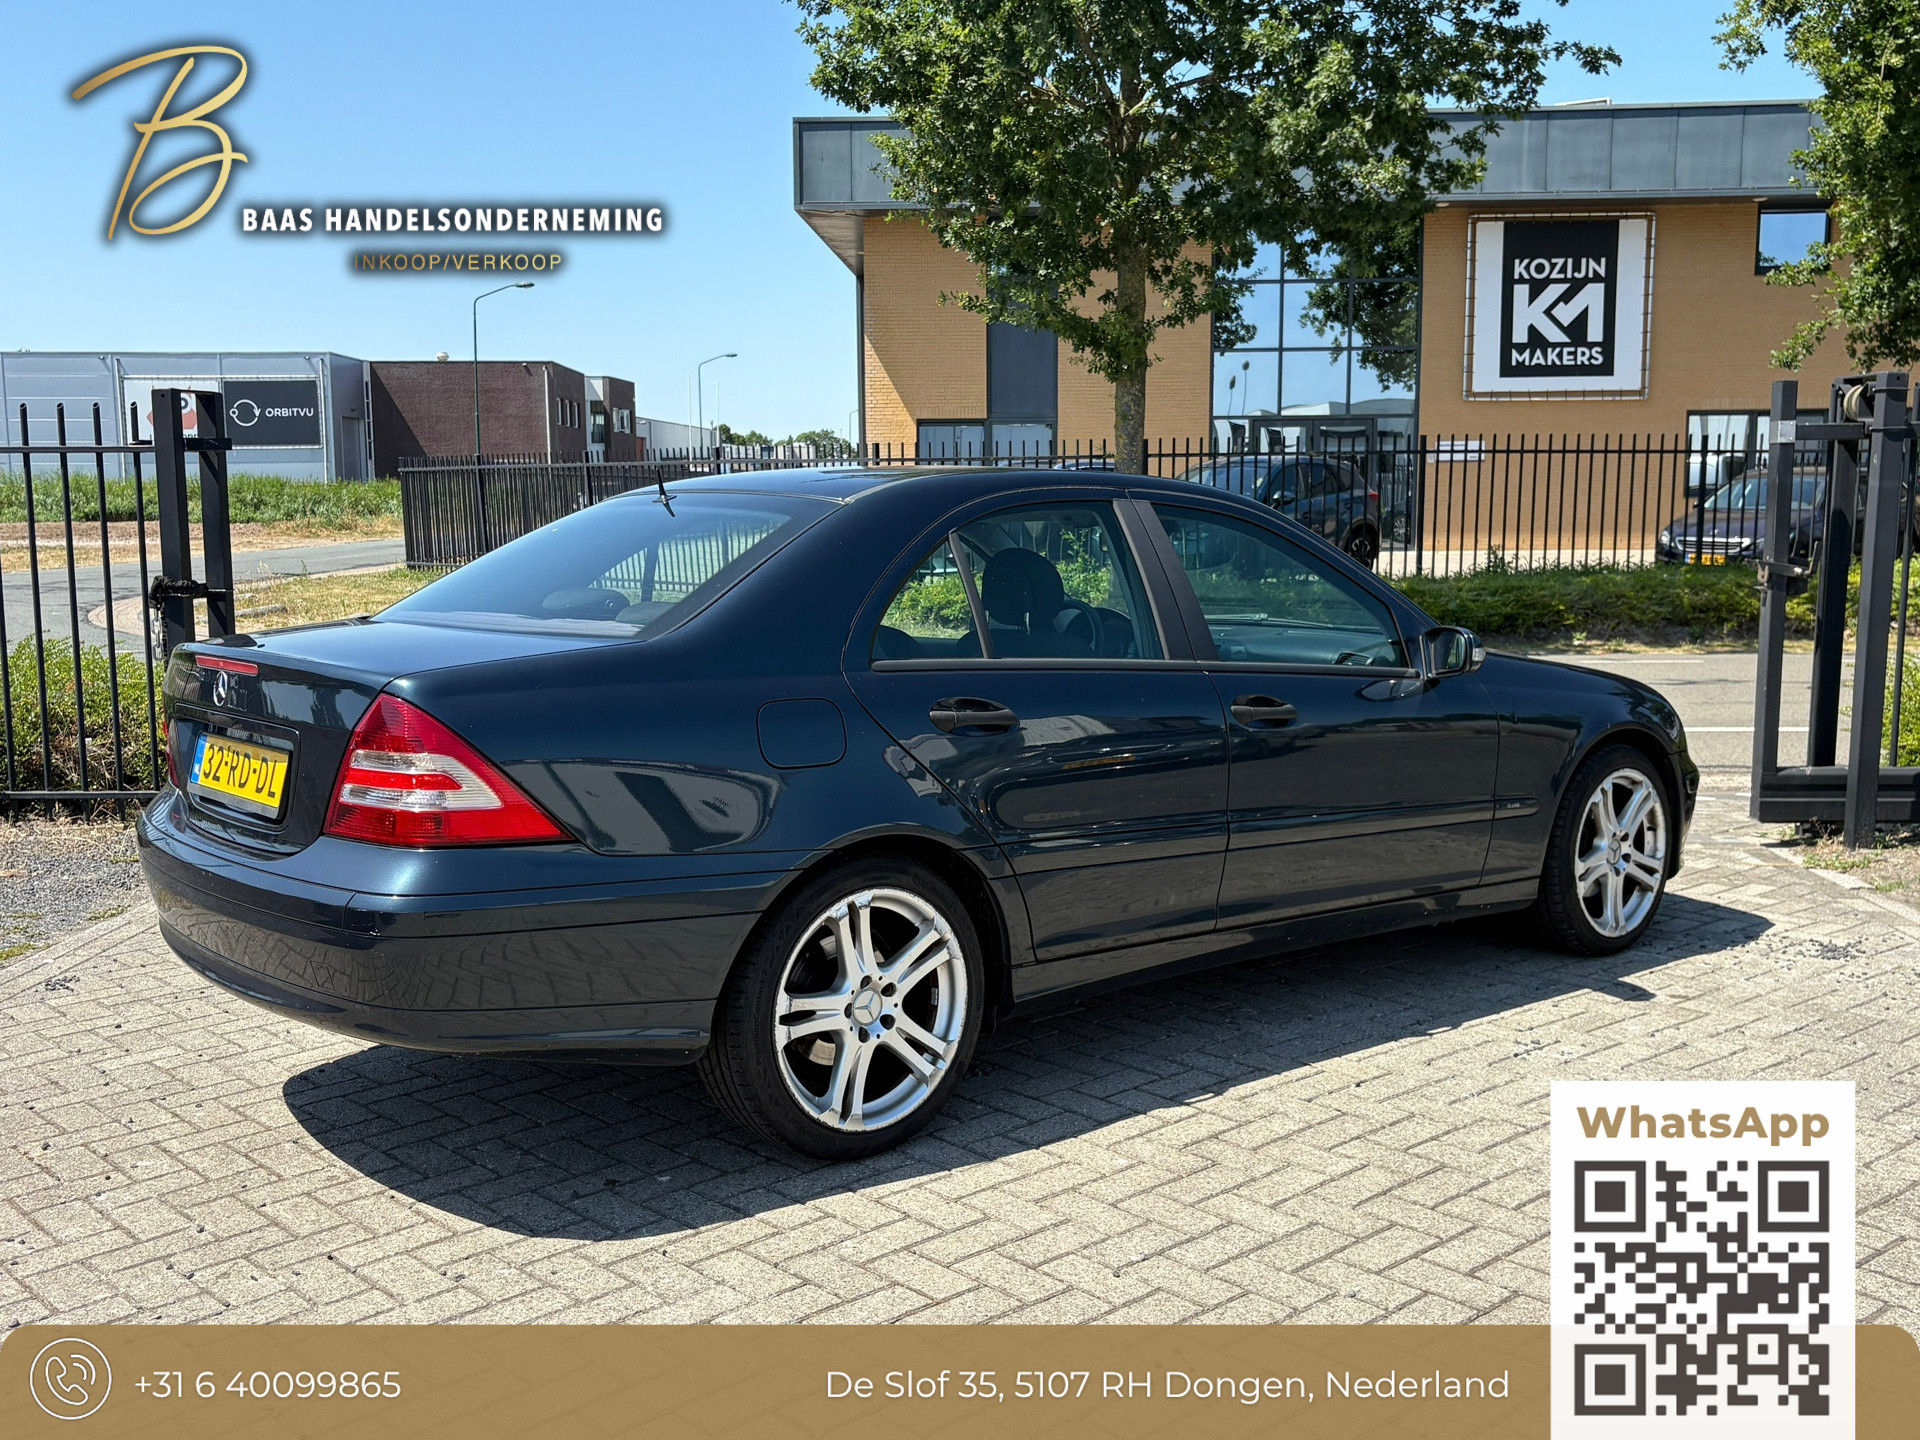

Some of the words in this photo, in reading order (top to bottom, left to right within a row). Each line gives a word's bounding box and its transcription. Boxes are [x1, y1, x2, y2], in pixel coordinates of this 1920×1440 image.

[1513, 257, 1606, 280] KOZIJN
[1511, 346, 1603, 366] MAKERS
[265, 407, 314, 418] ORBITVU
[203, 743, 278, 799] 32-RD-DL
